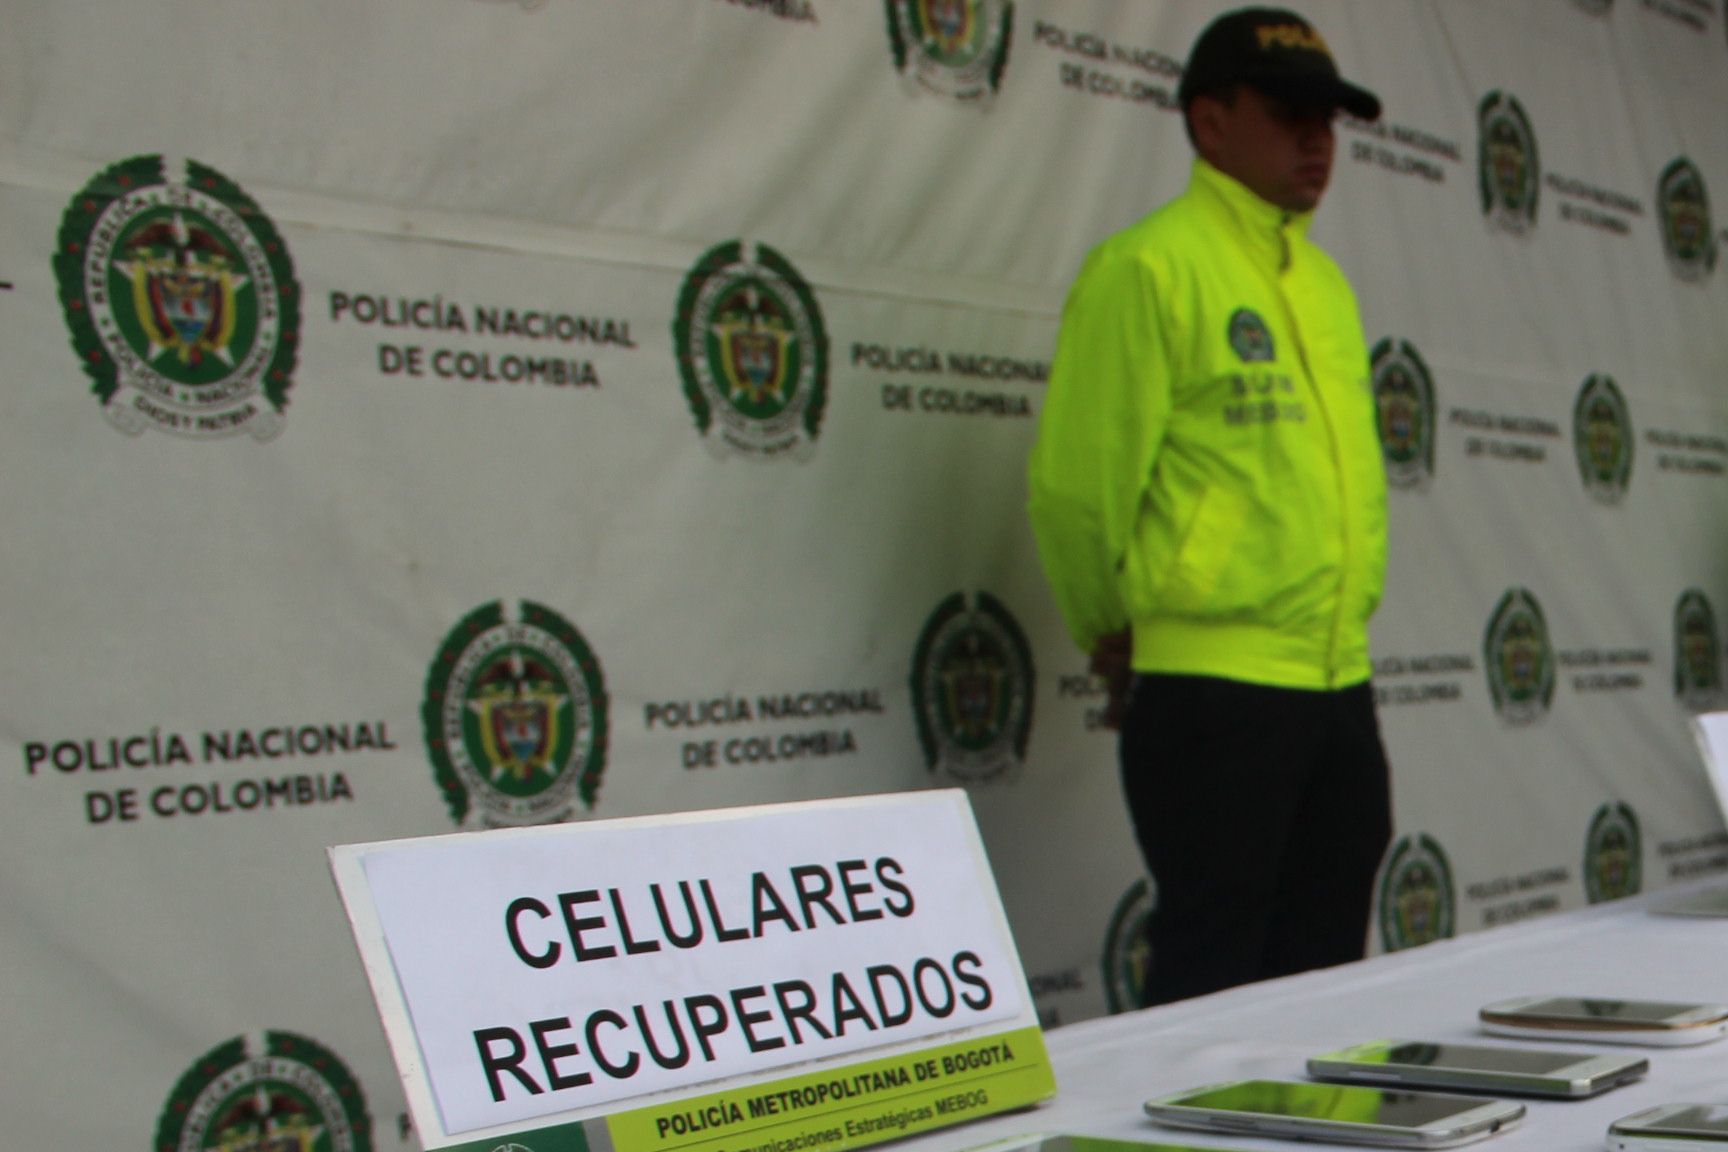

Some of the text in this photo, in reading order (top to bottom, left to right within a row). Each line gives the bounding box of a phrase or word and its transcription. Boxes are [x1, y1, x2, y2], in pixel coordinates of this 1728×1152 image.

[330, 290, 638, 349] POLICÍA NACIONAL
[378, 343, 601, 388] DE COLOMBIA
[881, 384, 914, 412] DE
[644, 686, 886, 730] POLICÍA NACIONAL
[22, 720, 398, 776] POLICÍA NACIONAL
[682, 730, 858, 771] DE COLOMBIA
[84, 772, 355, 825] DE COLOMBIA
[504, 856, 916, 970] CELULARES
[473, 950, 994, 1102] RECUPERADOS
[656, 1042, 1016, 1139] POLICÍA METROPOLITANA DE BOGOTÁ
[844, 1104, 934, 1140] Estratégicas
[935, 1088, 990, 1116] MEBOG
